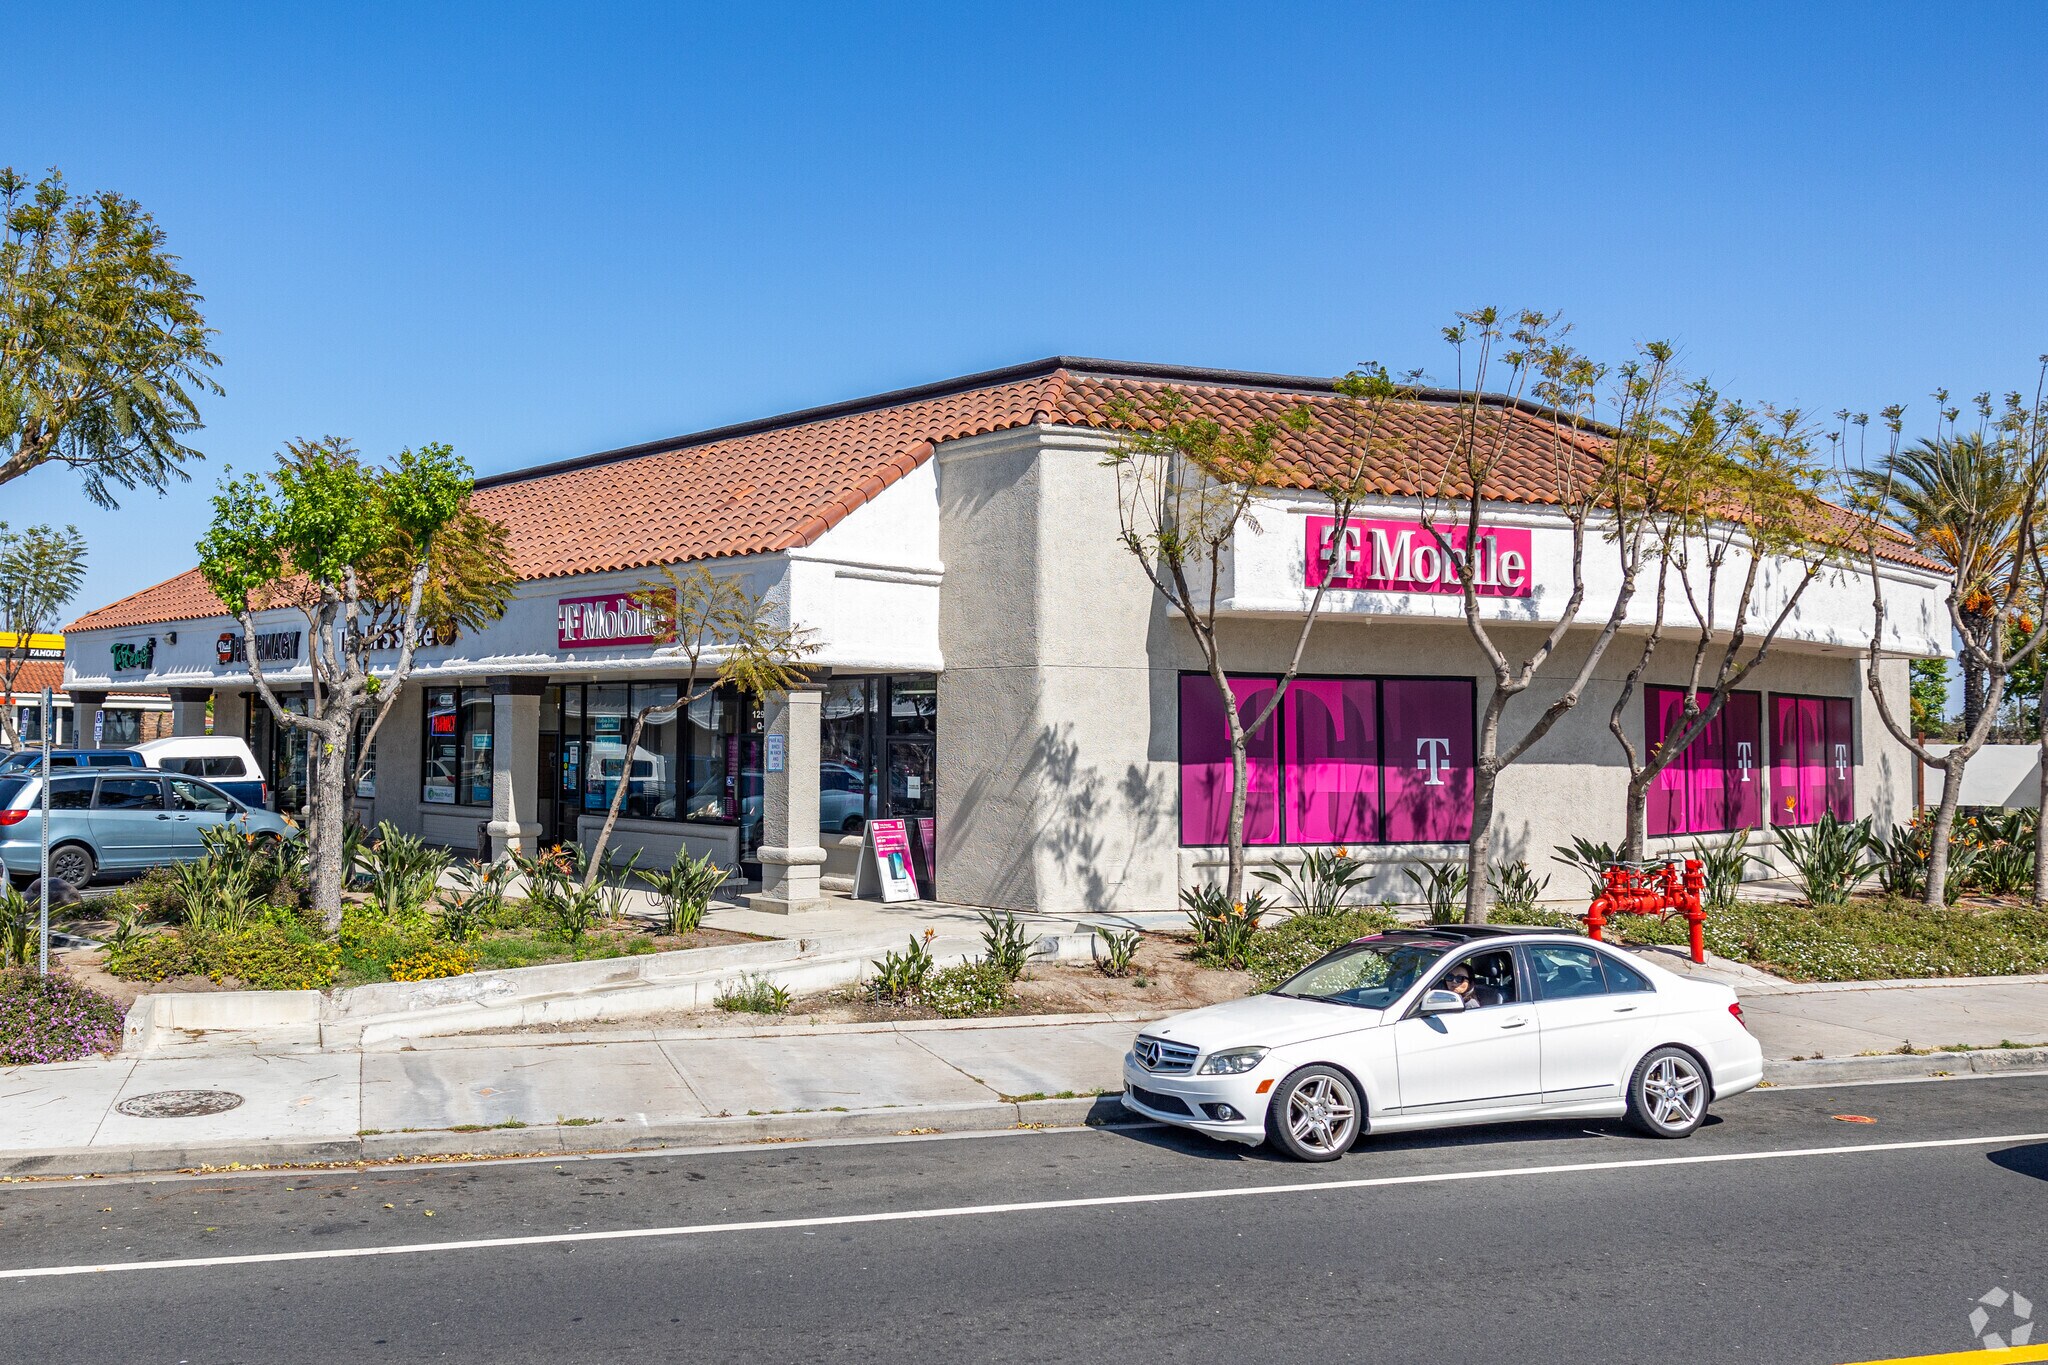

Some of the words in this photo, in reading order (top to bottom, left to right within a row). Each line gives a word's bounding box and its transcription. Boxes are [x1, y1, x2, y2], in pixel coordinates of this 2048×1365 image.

[1368, 528, 1526, 588] Mobile
[581, 598, 667, 640] Mobile
[29, 649, 62, 658] FAMOUS
[1417, 738, 1449, 785] T
[1737, 742, 1752, 782] T
[1835, 744, 1847, 780] T
